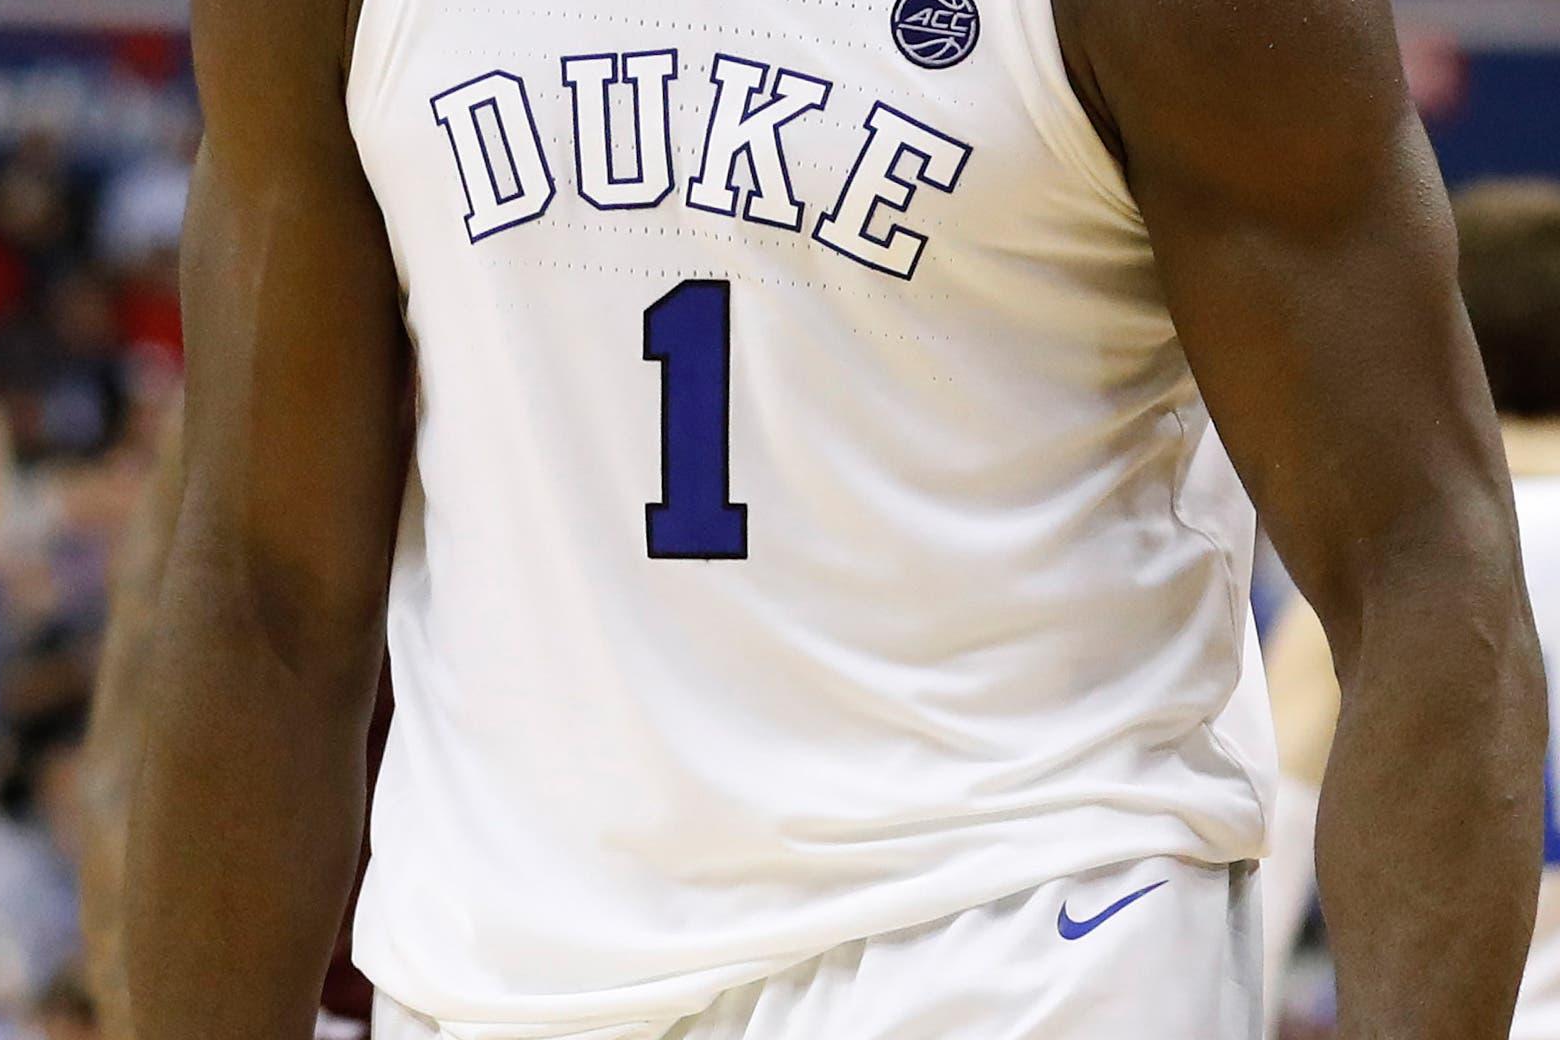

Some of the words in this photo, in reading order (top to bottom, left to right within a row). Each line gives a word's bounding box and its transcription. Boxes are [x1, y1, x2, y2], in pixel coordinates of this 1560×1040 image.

[904, 7, 976, 32] ACC
[430, 48, 974, 281] DUKE
[643, 279, 748, 560] 1
